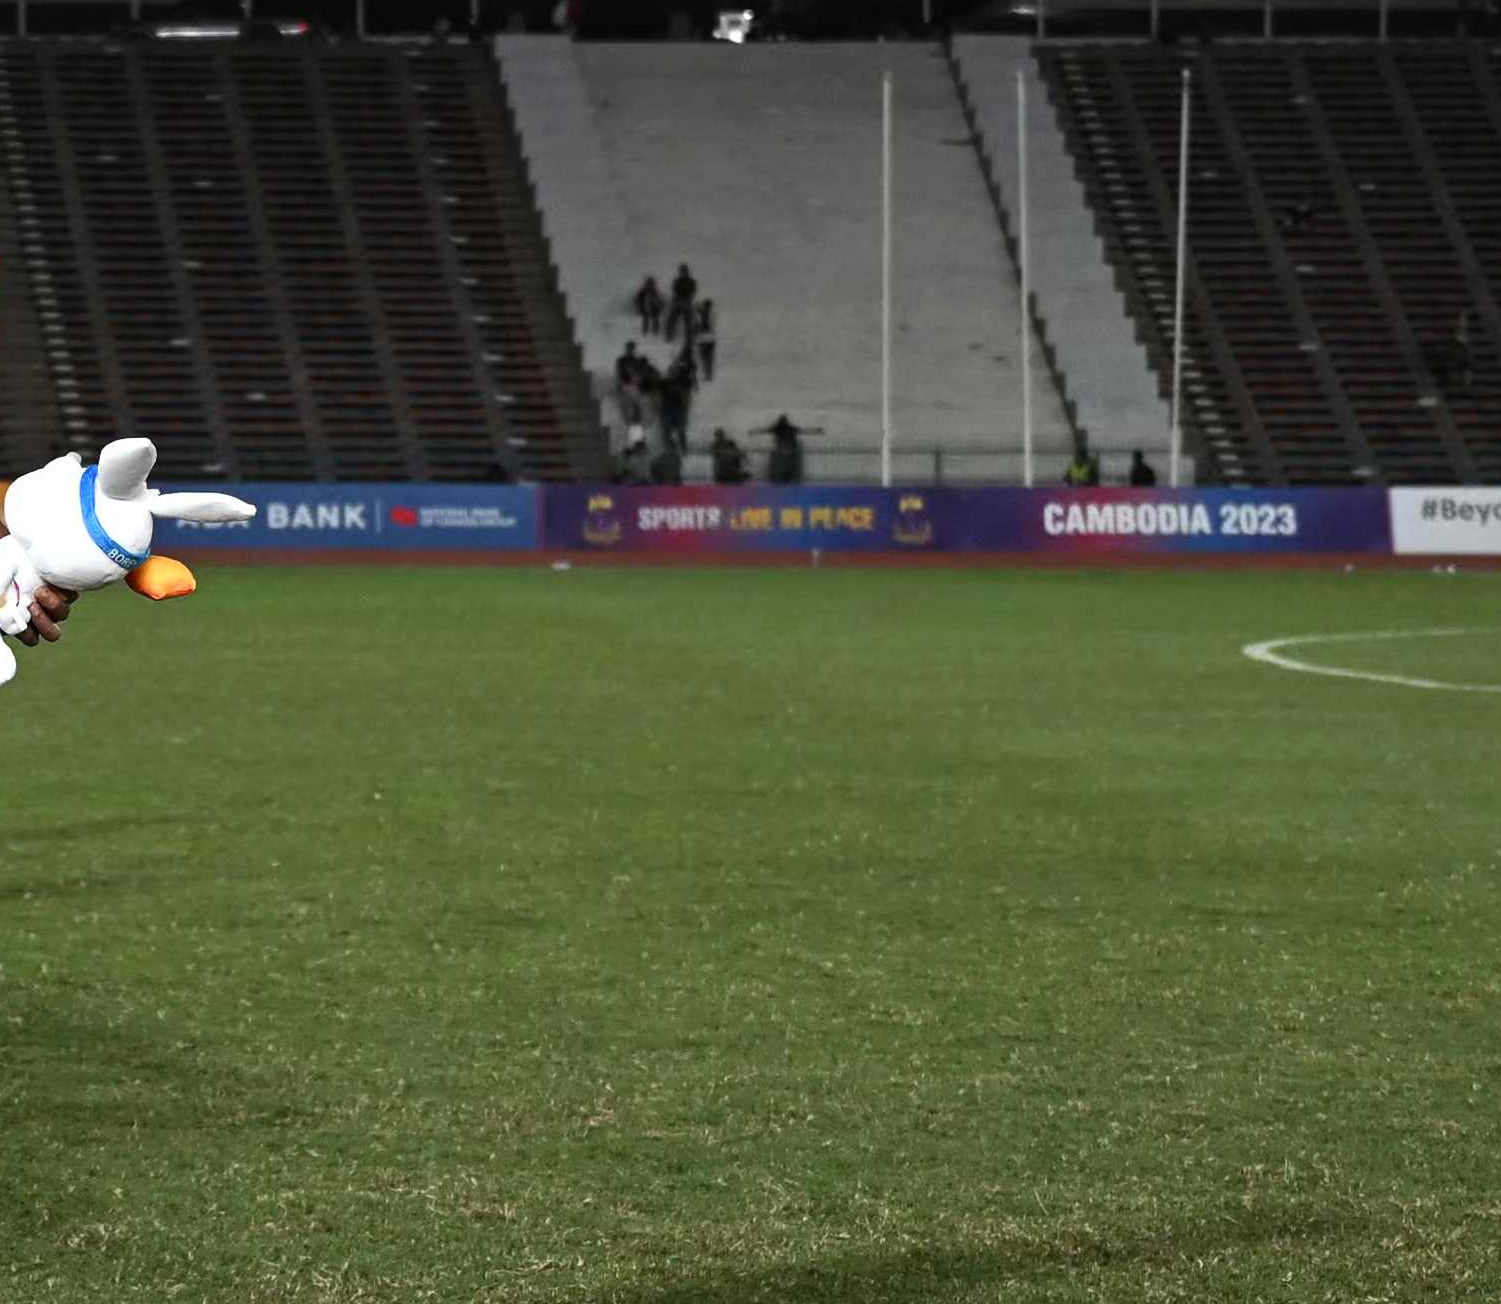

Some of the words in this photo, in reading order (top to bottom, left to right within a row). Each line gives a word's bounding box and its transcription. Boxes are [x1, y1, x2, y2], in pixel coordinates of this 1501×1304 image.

[266, 502, 367, 530] BANK
[637, 507, 722, 531] SPORTS
[780, 508, 802, 530] IN
[809, 508, 874, 530] PEACE
[1043, 502, 1212, 536] CAMBODIA
[1219, 503, 1297, 536] 2023
